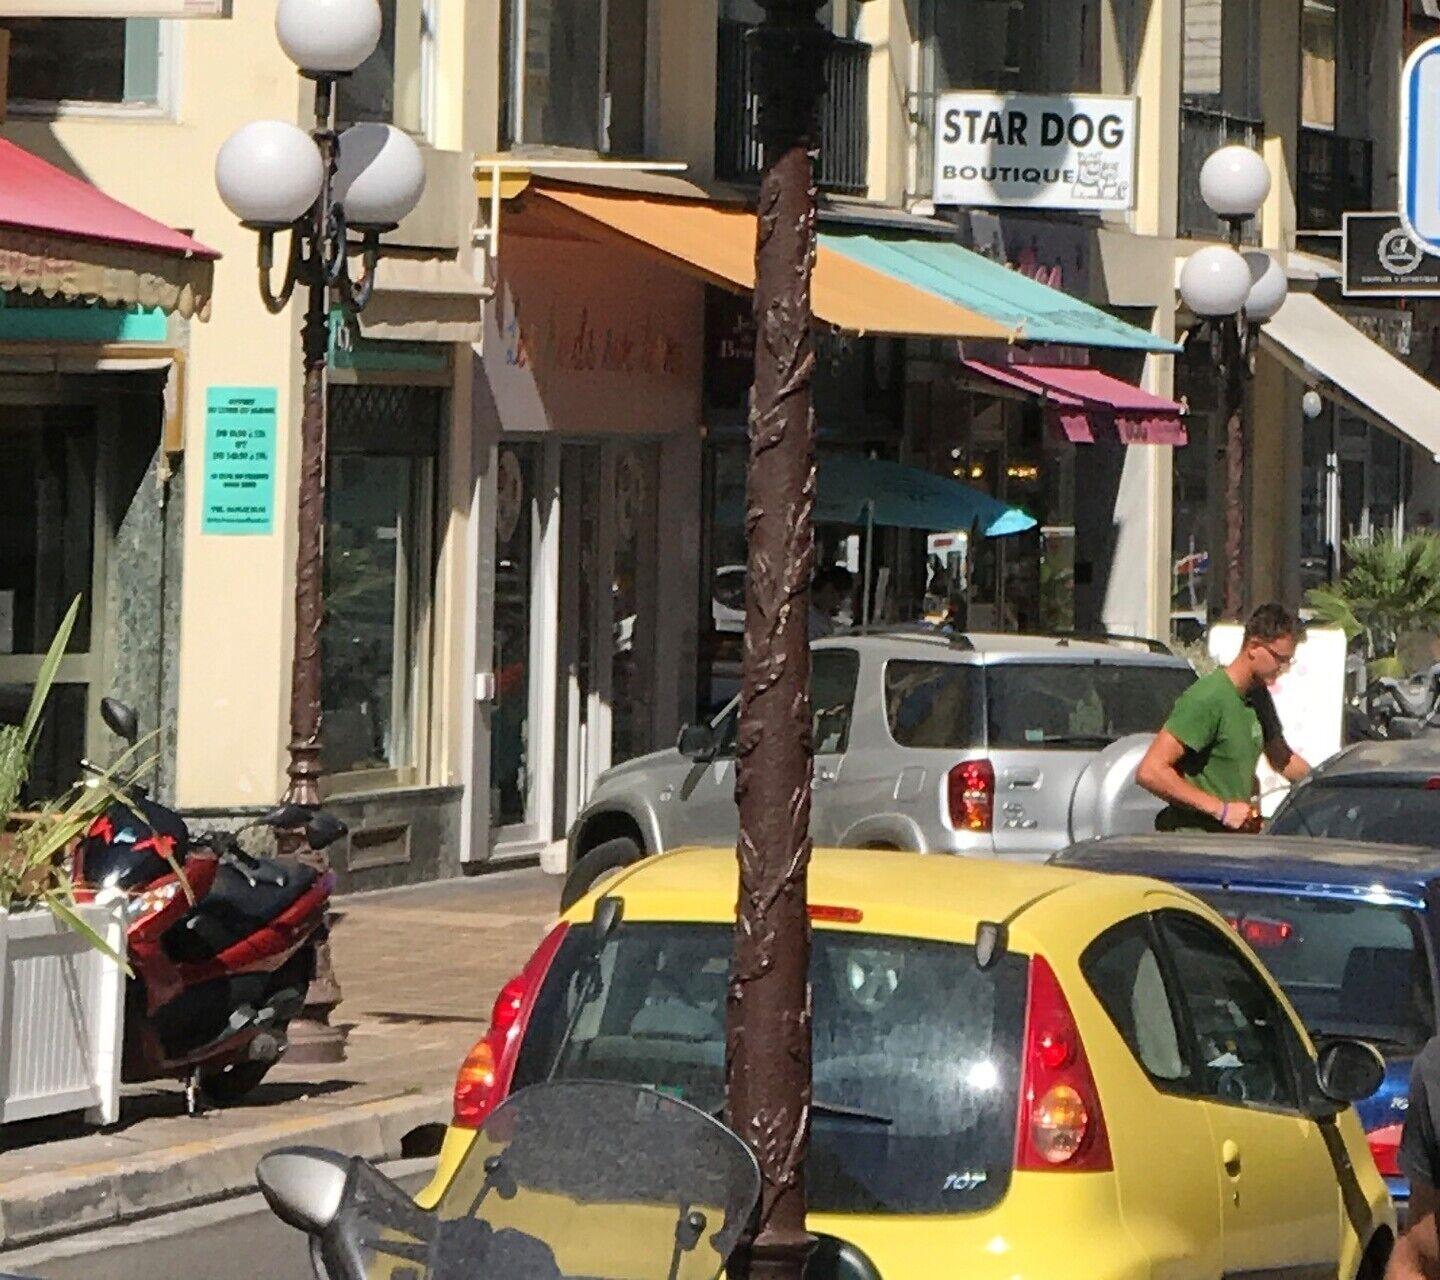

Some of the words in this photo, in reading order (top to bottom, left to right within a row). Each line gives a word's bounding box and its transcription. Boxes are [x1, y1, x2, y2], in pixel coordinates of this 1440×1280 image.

[943, 109, 1028, 146] STAR
[1041, 112, 1125, 149] DOG
[943, 164, 1075, 184] BOUTIQUE
